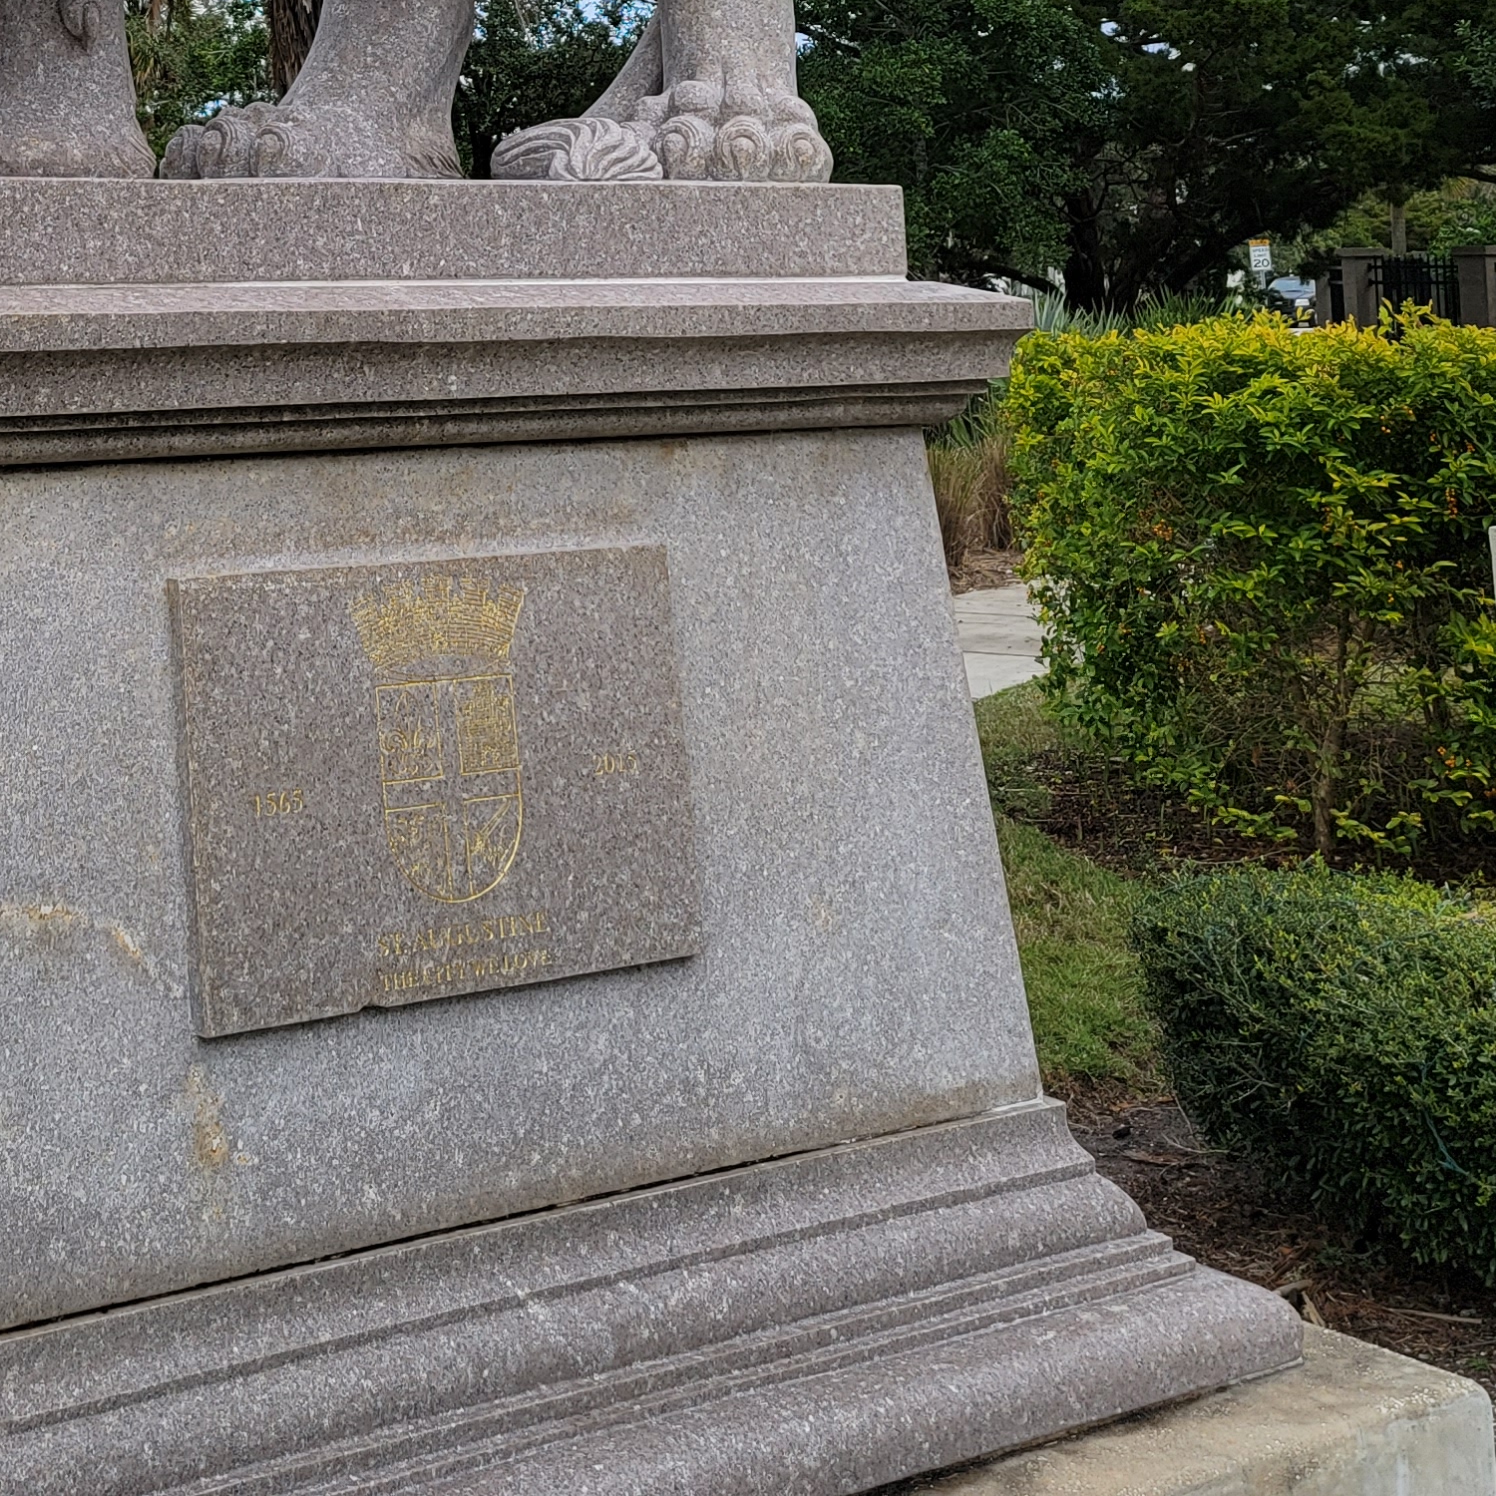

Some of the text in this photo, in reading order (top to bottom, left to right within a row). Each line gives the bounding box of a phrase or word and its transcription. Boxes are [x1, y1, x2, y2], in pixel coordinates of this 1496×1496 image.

[1253, 258, 1270, 268] 20
[255, 789, 303, 818] 1565
[413, 909, 551, 952] AUGUSTINE
